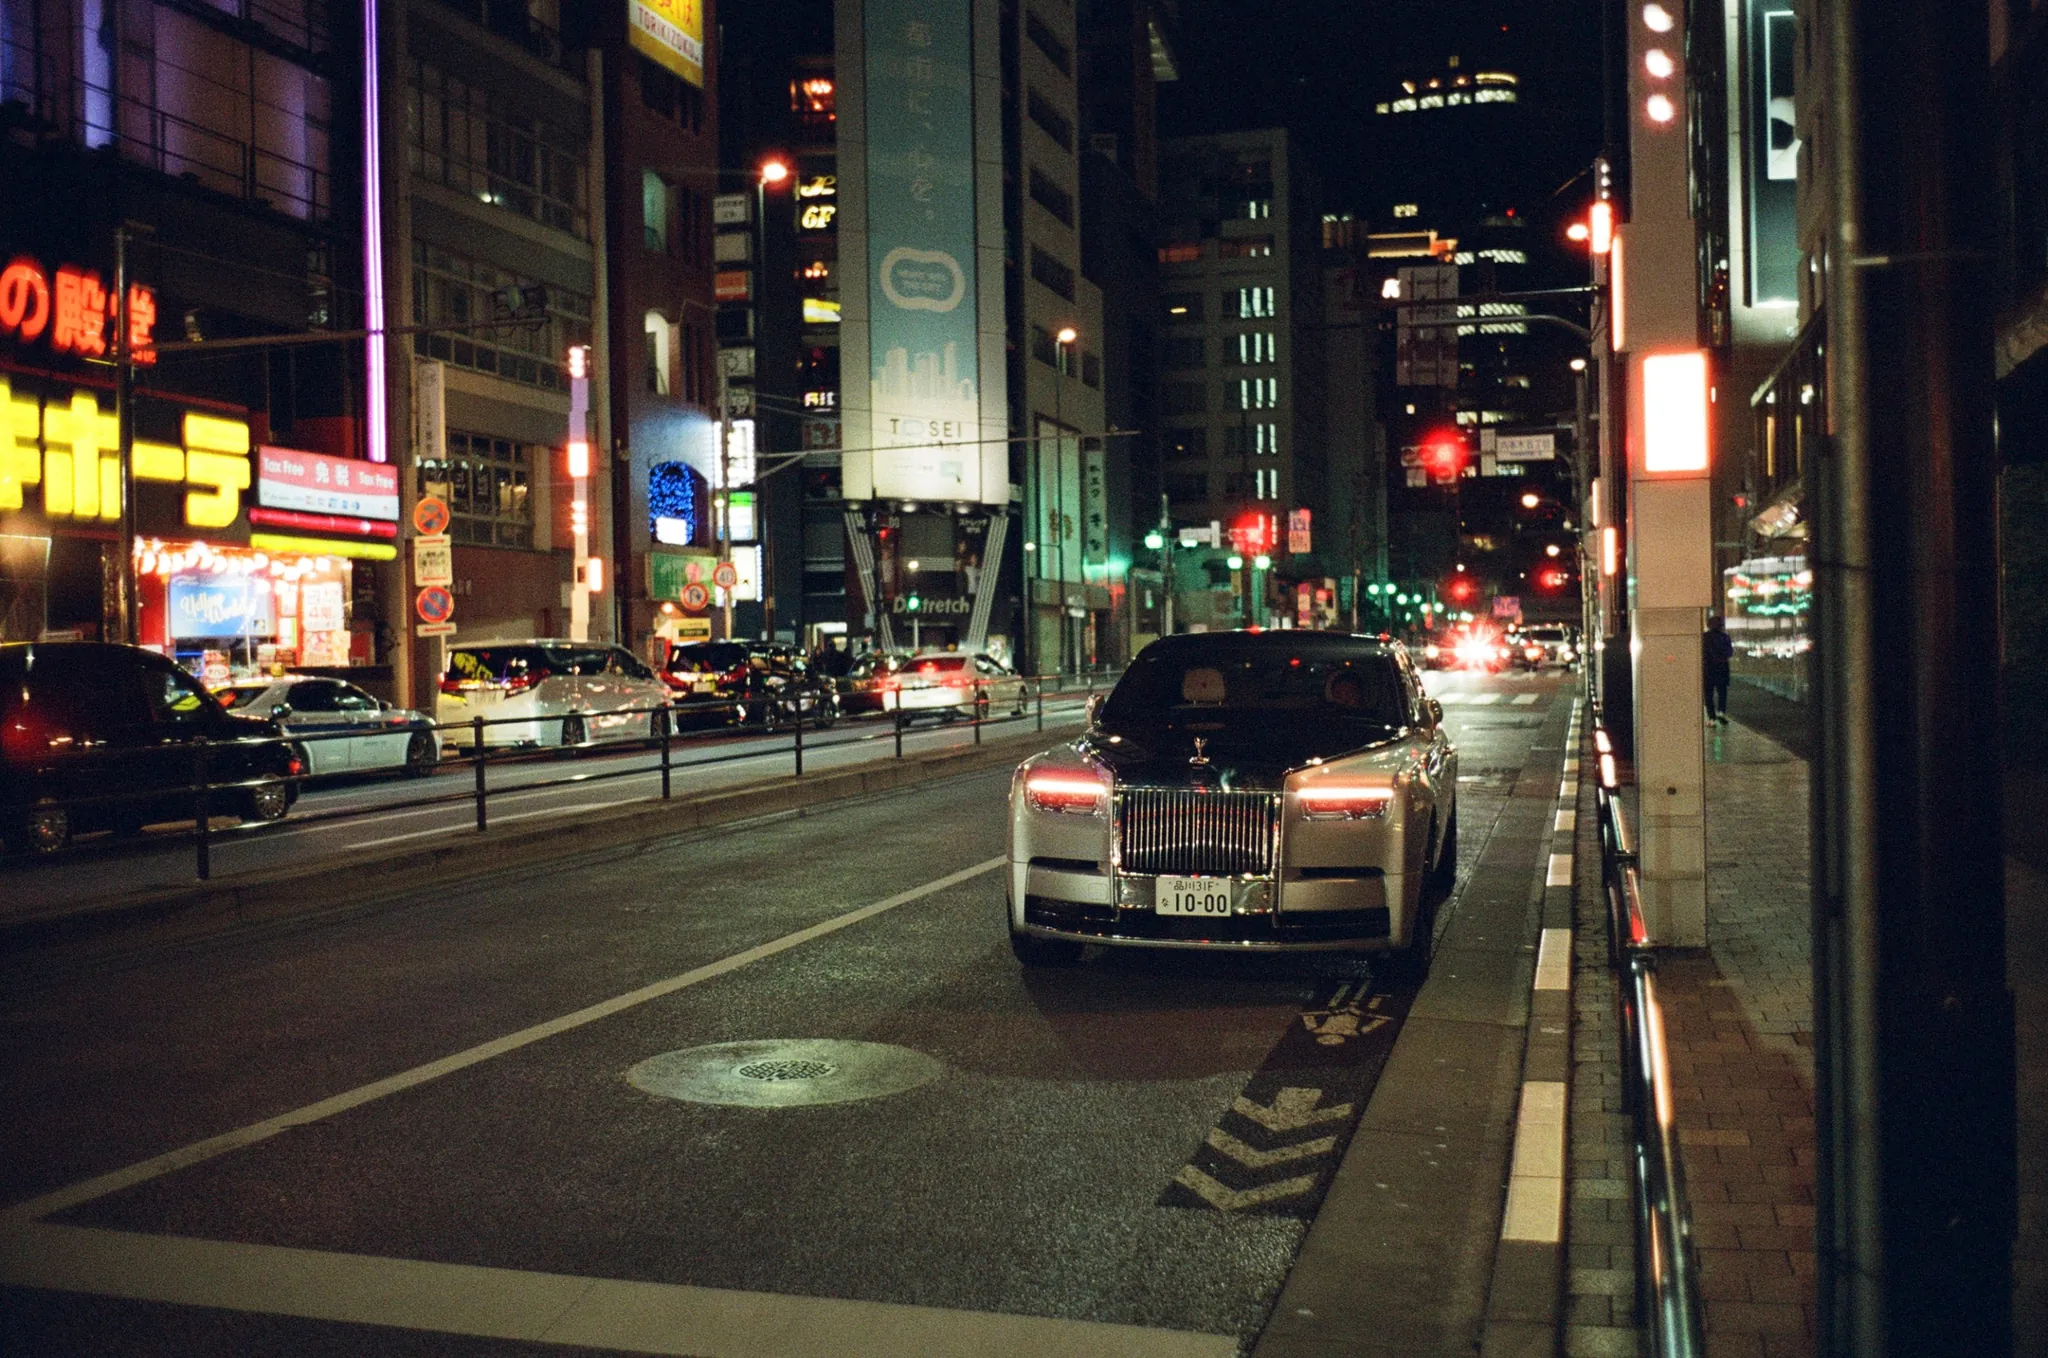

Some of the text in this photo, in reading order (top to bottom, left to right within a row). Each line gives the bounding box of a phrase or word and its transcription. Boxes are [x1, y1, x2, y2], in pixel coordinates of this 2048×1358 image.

[637, 5, 700, 61] TORIKIZOKU
[1174, 880, 1195, 891] 品川
[1176, 893, 1227, 913] 10-00
